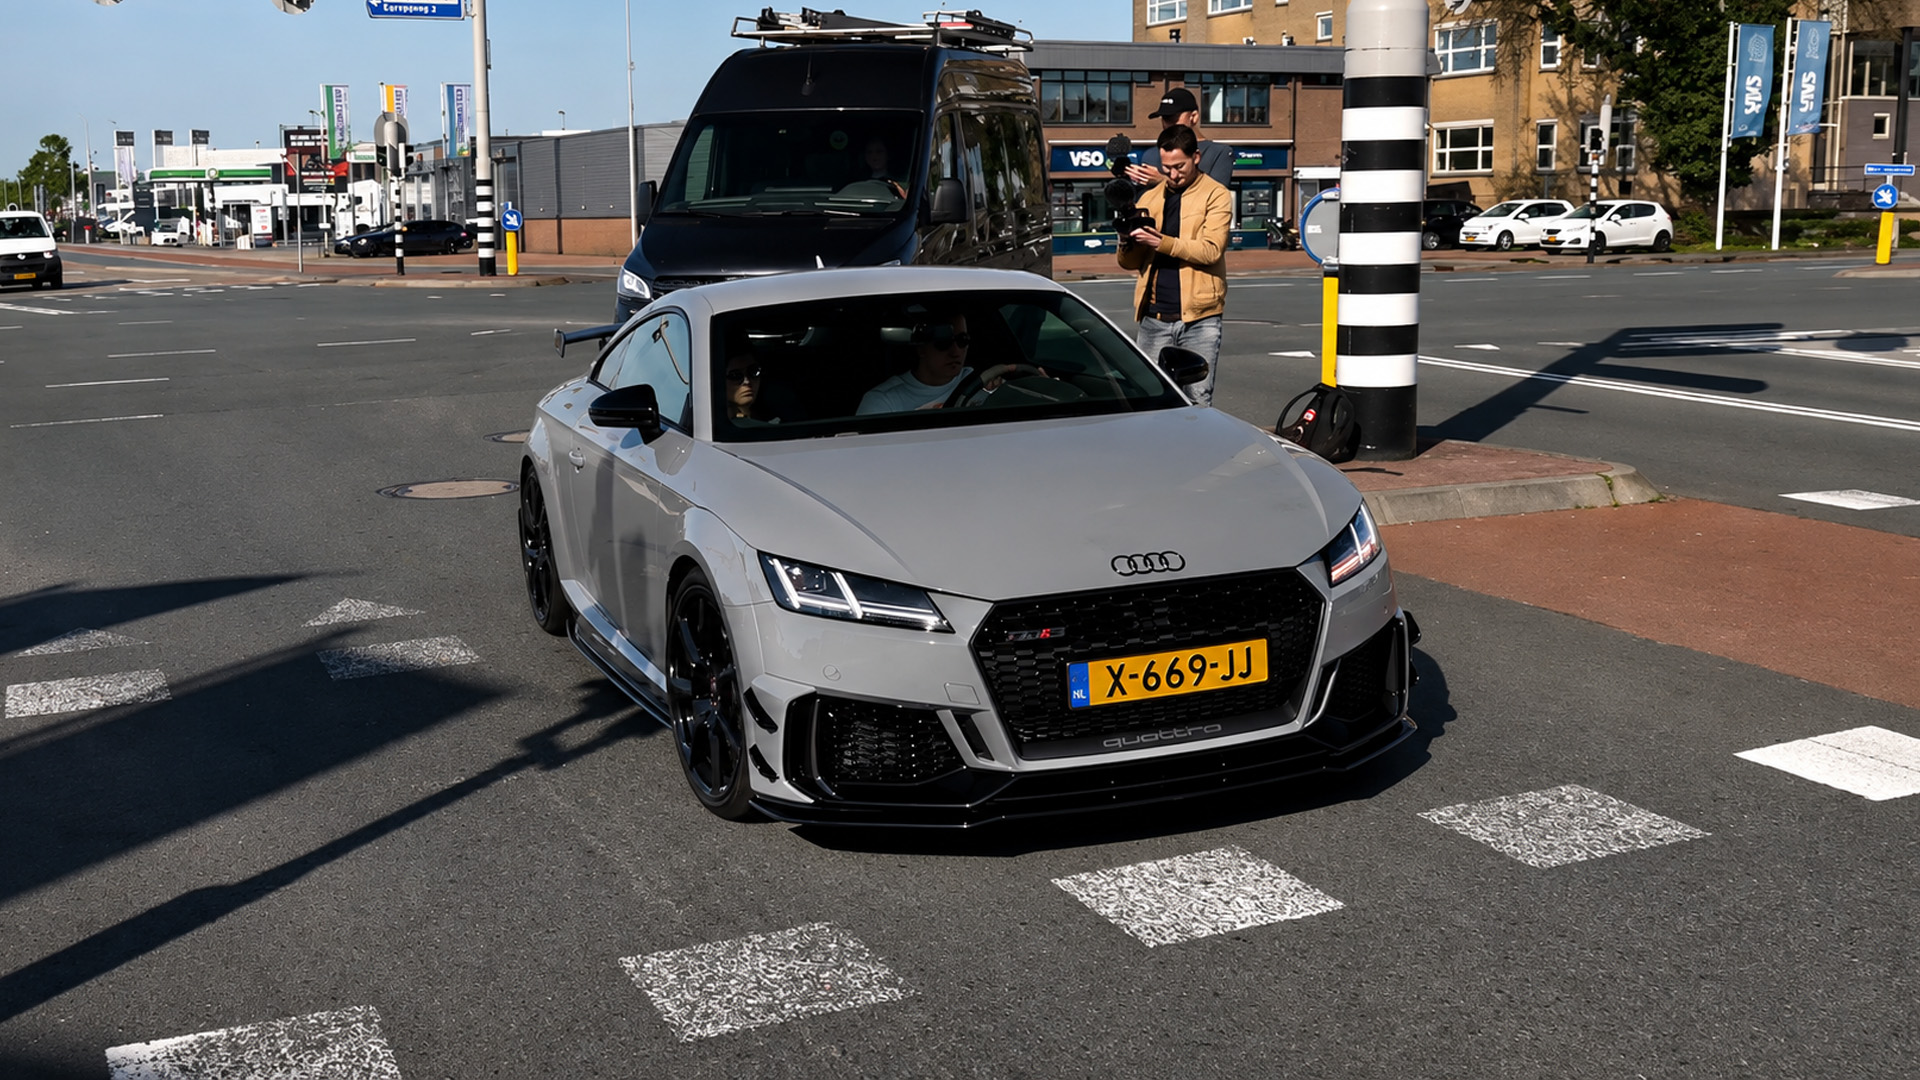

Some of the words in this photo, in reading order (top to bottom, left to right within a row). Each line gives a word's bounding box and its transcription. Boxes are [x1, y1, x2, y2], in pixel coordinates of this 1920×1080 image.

[1069, 151, 1105, 167] VSO
[1106, 646, 1252, 698] X-669-JJ
[1072, 689, 1087, 699] NL
[1103, 723, 1222, 748] quattro
